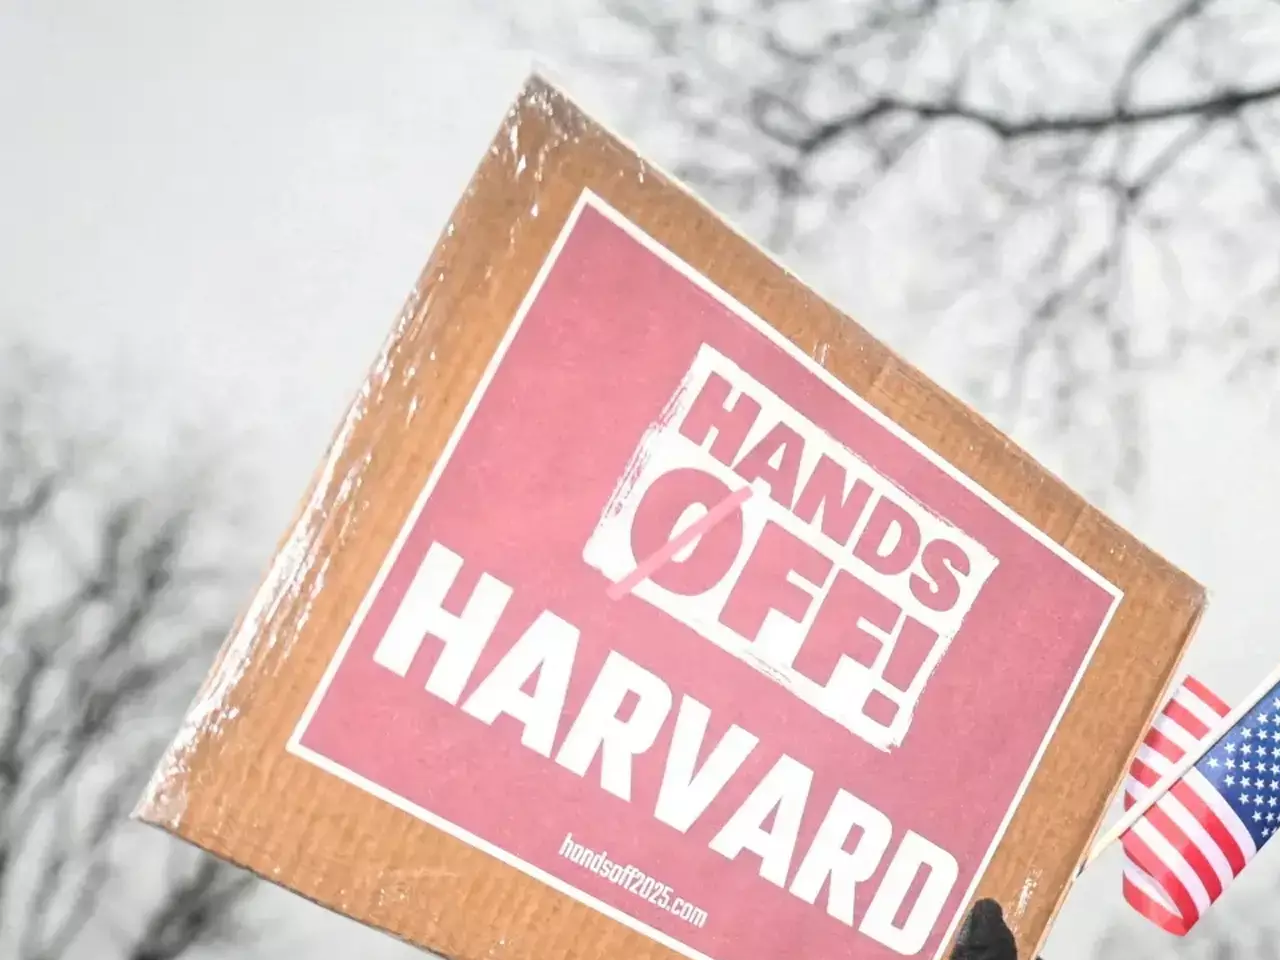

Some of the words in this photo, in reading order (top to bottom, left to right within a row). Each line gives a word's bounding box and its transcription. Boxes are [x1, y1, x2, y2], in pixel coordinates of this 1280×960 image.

[630, 466, 943, 732] OFF!
[678, 370, 971, 612] HANDS
[372, 541, 960, 956] HARVARD
[558, 831, 708, 929] handsoff2025.com
